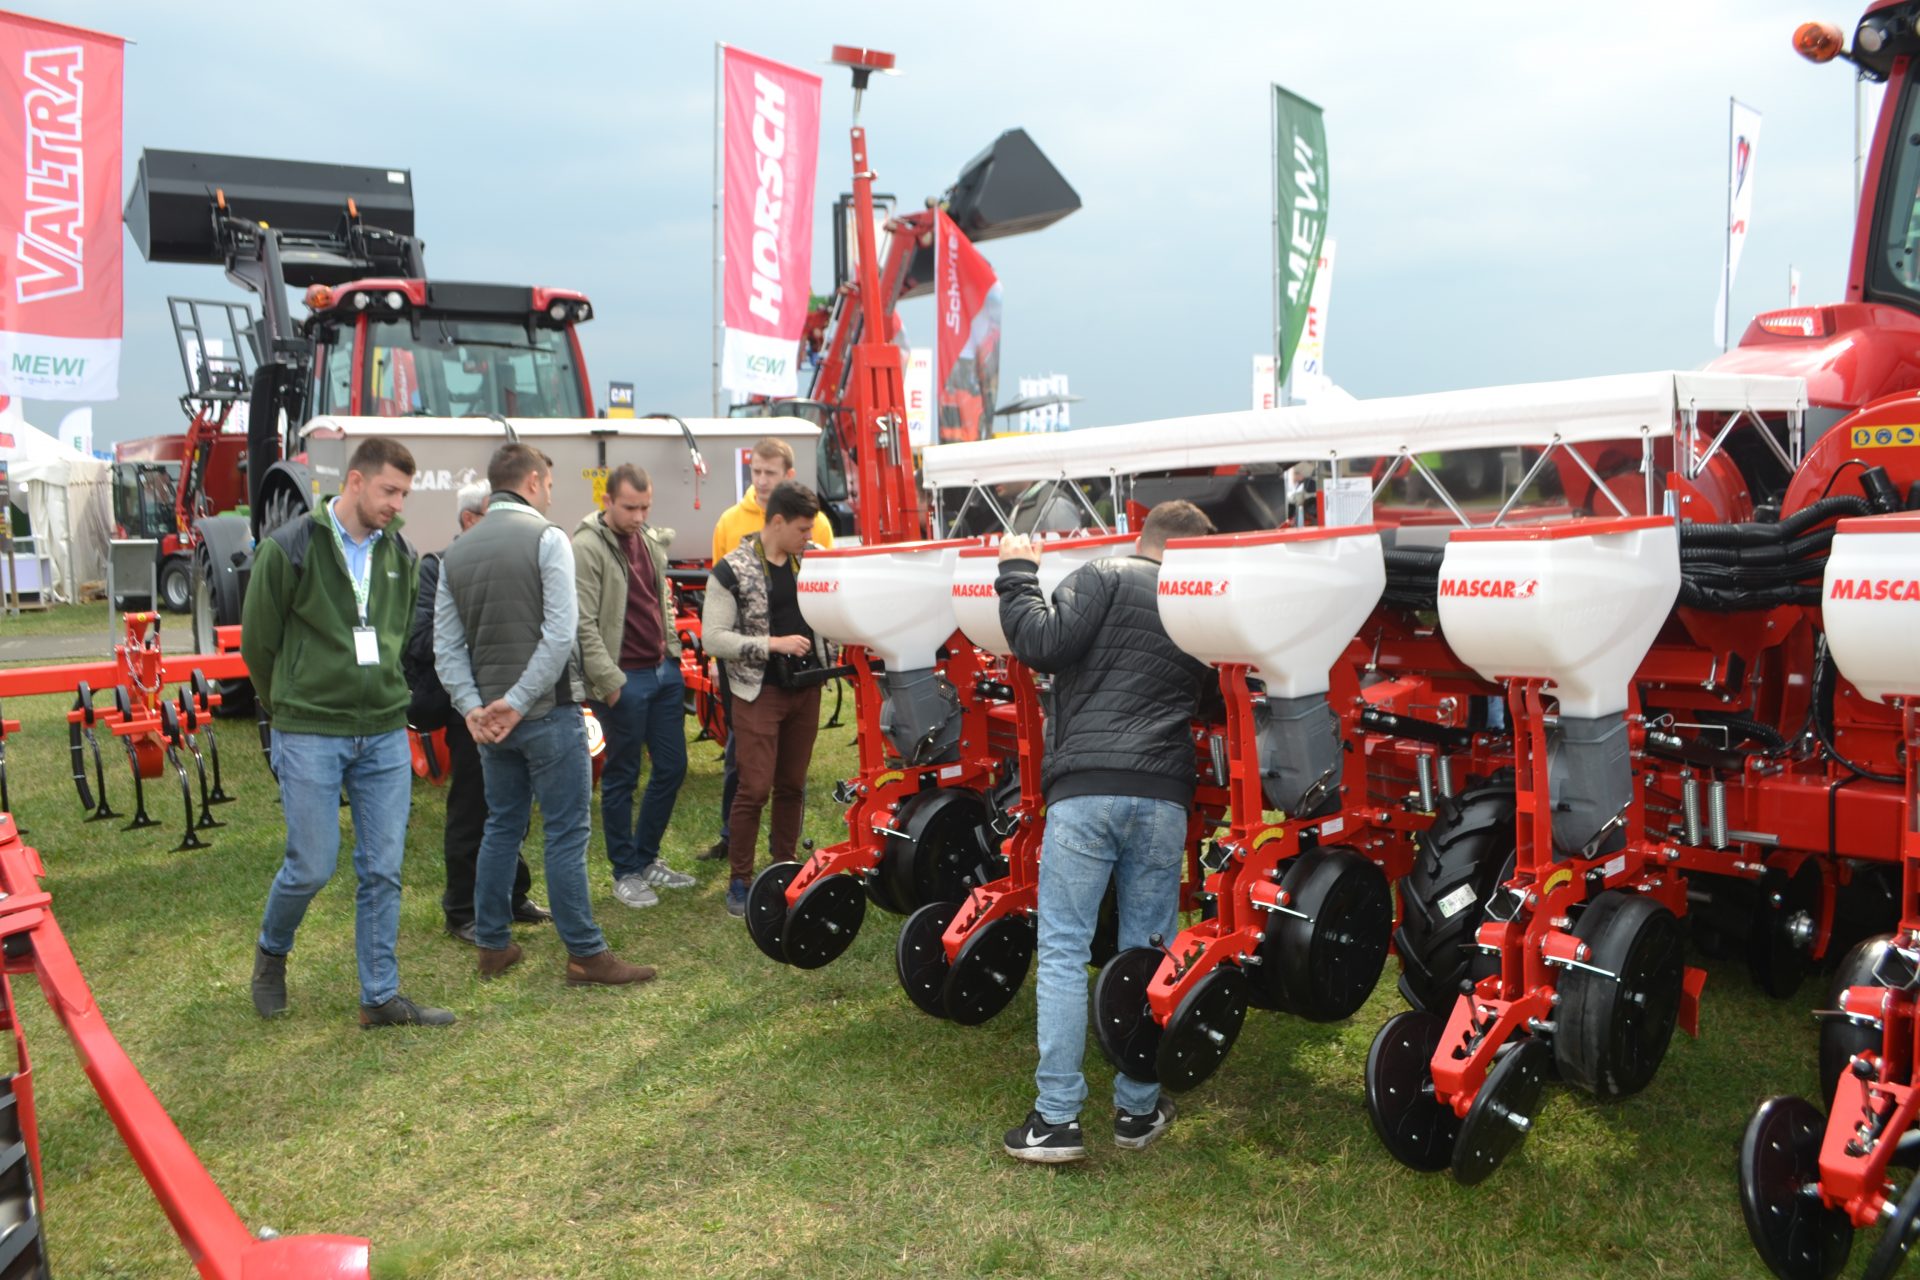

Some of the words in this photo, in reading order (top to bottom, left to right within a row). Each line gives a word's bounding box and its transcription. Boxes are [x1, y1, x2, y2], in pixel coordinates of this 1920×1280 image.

[16, 45, 83, 304] VALTRA
[749, 71, 785, 326] HORSCH
[12, 352, 86, 377] MEWI
[611, 387, 632, 403] CAT
[797, 581, 829, 593] MASCAR
[952, 584, 993, 597] MASCAR
[1158, 581, 1213, 596] MASCAR
[1440, 579, 1516, 598] MASCAR
[1831, 579, 1920, 601] MASCA
